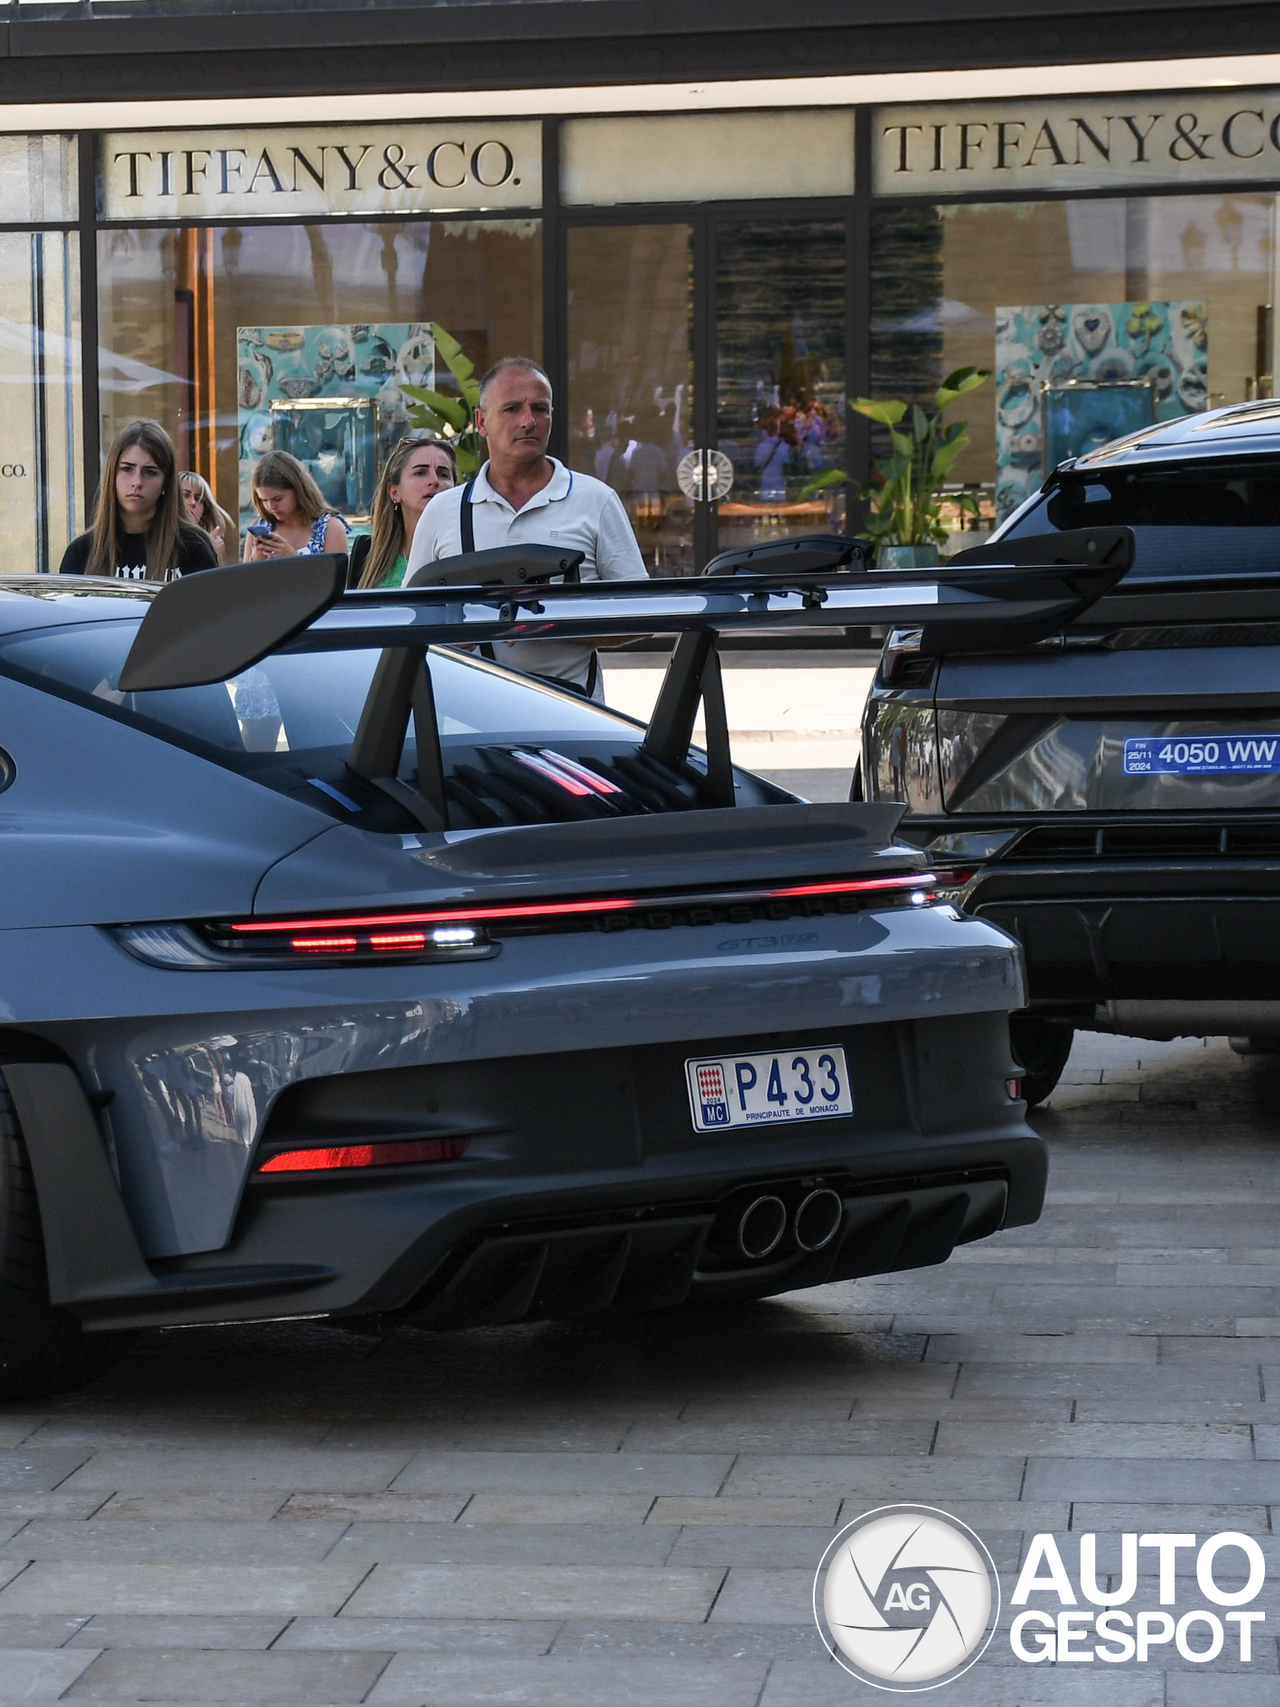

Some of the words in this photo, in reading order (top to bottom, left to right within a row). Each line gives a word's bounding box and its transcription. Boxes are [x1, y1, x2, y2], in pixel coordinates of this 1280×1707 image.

[883, 109, 1280, 173] TIFFANY&C
[114, 140, 522, 197] TIFFANY&CO.
[1128, 751, 1152, 760] 25/11
[1158, 742, 1220, 764] 4050
[1227, 740, 1278, 762] WW
[1129, 762, 1151, 771] 2024
[604, 896, 860, 932] PORSCHE
[734, 1054, 841, 1111] P433
[707, 1107, 724, 1122] MC
[746, 1108, 791, 1121] PRINCIPAUTE
[795, 1107, 805, 1116] DE
[809, 1103, 840, 1114] MONACO
